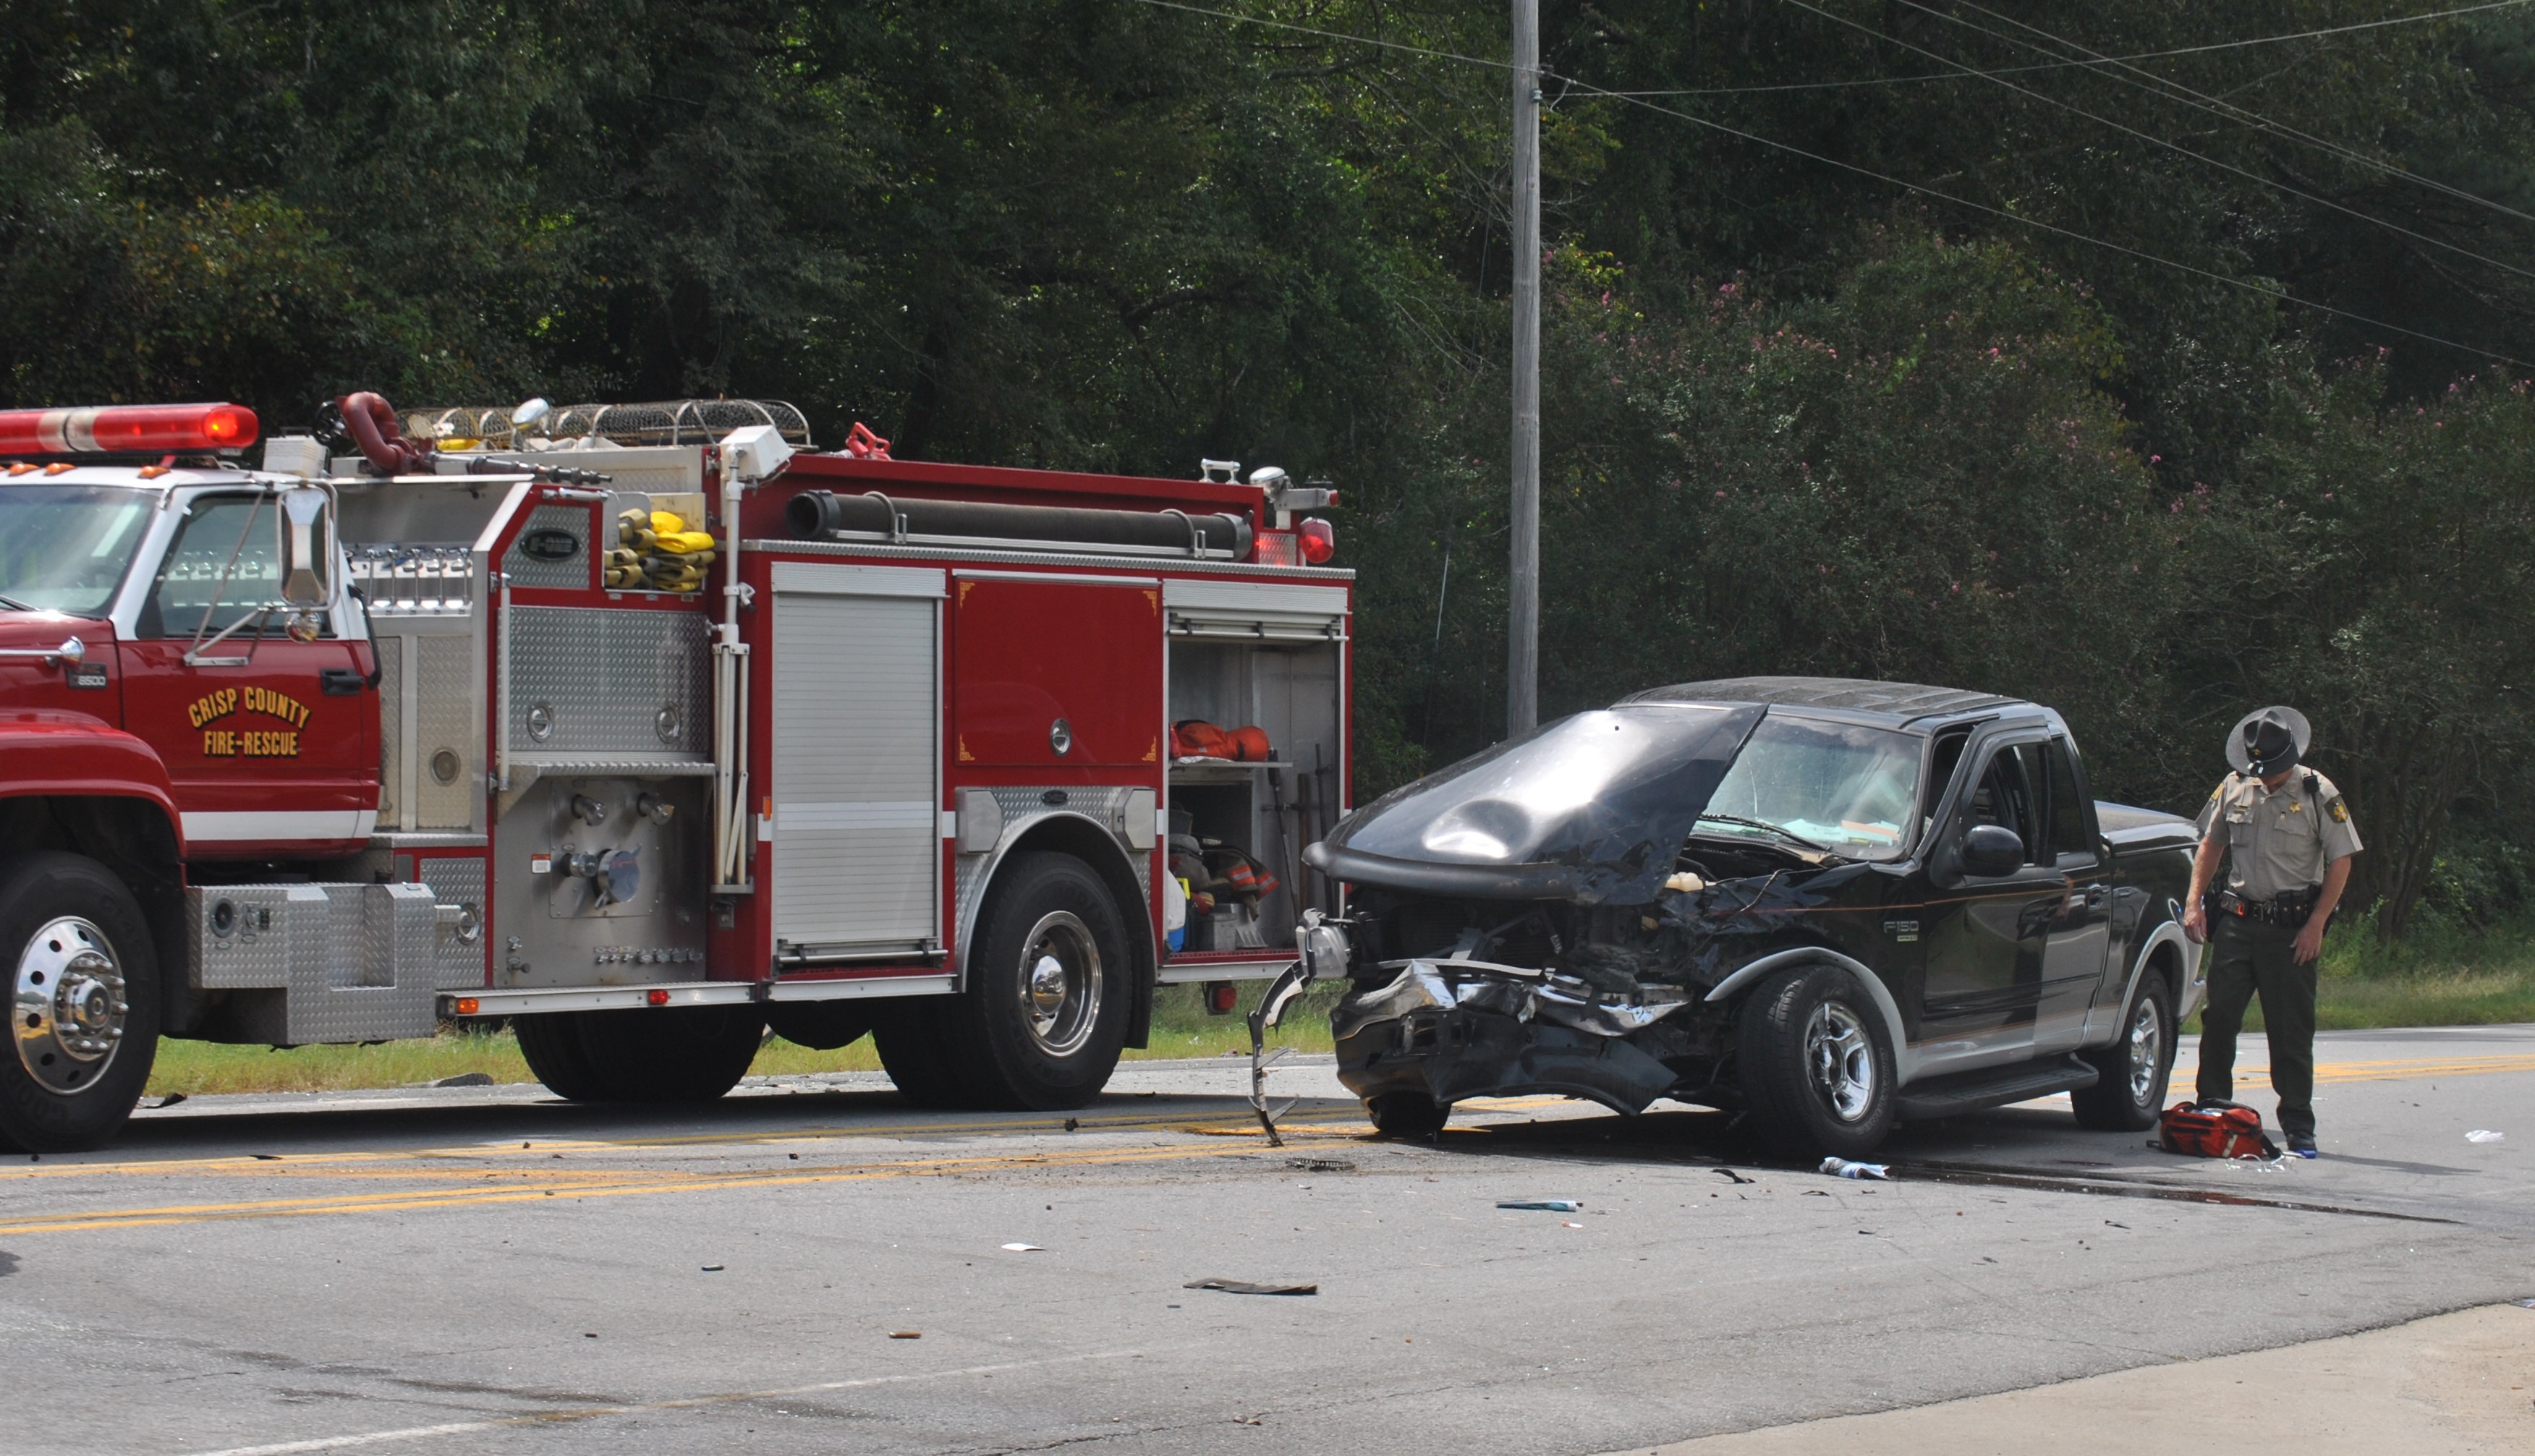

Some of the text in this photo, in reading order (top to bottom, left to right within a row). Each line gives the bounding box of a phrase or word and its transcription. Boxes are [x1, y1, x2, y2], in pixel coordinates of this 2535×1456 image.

[188, 686, 311, 730] CRISP COUNTY
[203, 730, 299, 757] FIRE-RESCUE
